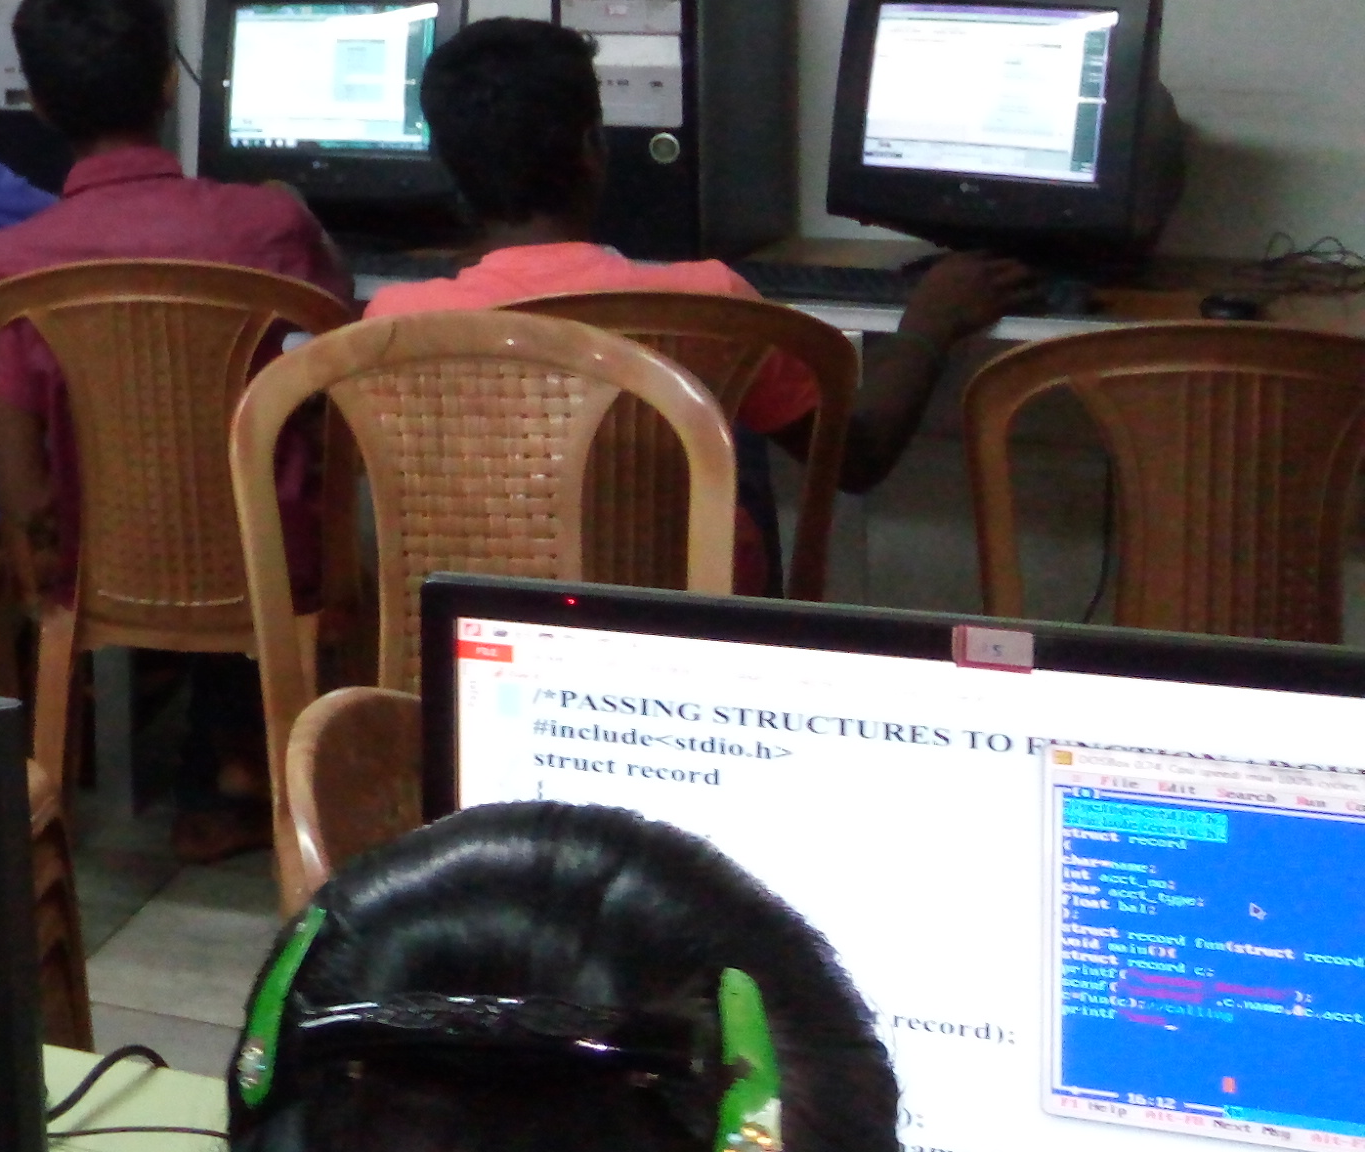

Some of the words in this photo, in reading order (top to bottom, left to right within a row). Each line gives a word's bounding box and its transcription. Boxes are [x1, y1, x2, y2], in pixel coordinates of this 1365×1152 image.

[533, 718, 793, 760] #include<stdio.h>
[713, 705, 952, 747] STRUCTURES
[963, 729, 1014, 753] TO
[533, 751, 617, 775] struct
[626, 761, 720, 786] record
[1100, 775, 1139, 789] File
[1158, 781, 1196, 795] Edit
[1216, 788, 1278, 803] Search
[1296, 796, 1326, 808] Run
[1062, 828, 1119, 843] struct
[1127, 835, 1188, 850] record
[1062, 867, 1091, 881] int
[1062, 881, 1101, 895] char
[1062, 923, 1119, 938] struct
[1127, 931, 1187, 946] record
[1062, 950, 1119, 966] struct
[1127, 958, 1187, 974] record
[1088, 1101, 1127, 1118] Help
[1212, 1119, 1251, 1133] Next
